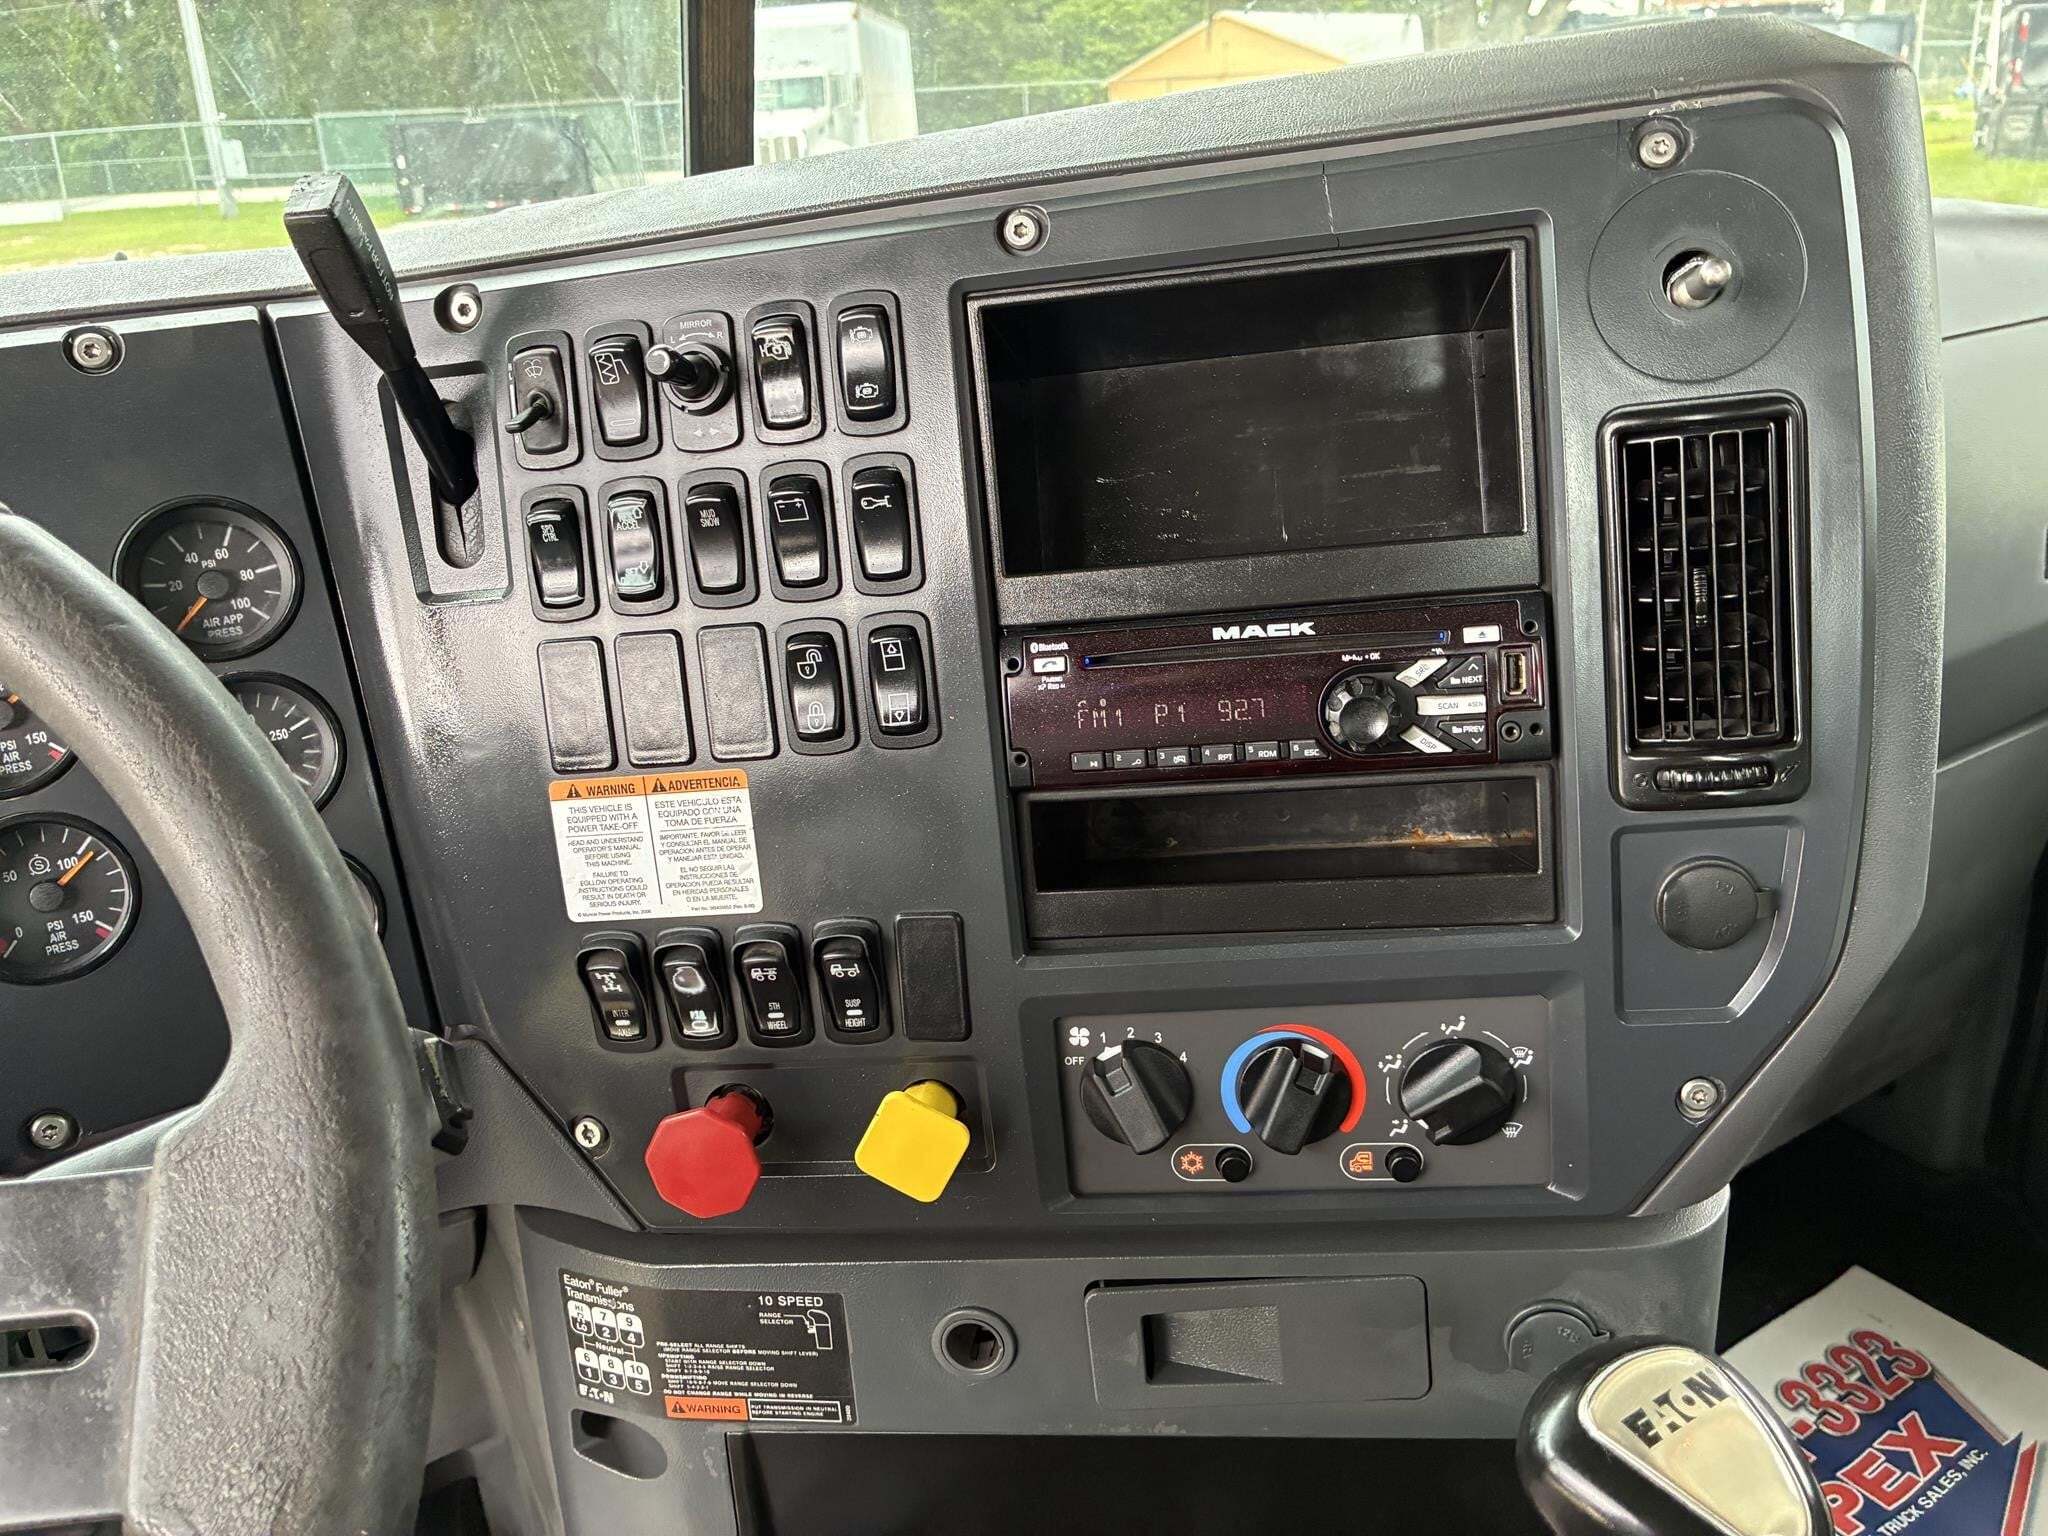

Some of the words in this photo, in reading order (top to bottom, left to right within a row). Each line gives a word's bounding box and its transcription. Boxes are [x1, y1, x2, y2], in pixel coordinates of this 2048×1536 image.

[680, 319, 712, 329] MIRROR
[670, 336, 676, 344] L
[716, 331, 723, 339] R
[700, 509, 716, 519] MUD
[616, 521, 641, 531] ACCEL
[700, 517, 720, 528] SNOW
[540, 524, 555, 535] SPD
[542, 533, 560, 543] CTRL
[184, 552, 199, 564] 40
[214, 548, 229, 560] 60
[201, 560, 217, 569] PSI
[240, 568, 255, 581] 80
[168, 580, 184, 592] 20
[231, 597, 251, 610] 100
[203, 616, 221, 628] AIR
[223, 613, 244, 626] APP
[207, 626, 244, 638] PRESS
[1212, 621, 1316, 640] MACK
[1038, 641, 1069, 652] Bluetooth
[1370, 652, 1381, 660] OK
[1461, 675, 1483, 684] NEXT
[1077, 708, 1122, 729] FM1
[1154, 702, 1186, 725] P1
[269, 727, 289, 742] 250
[1462, 725, 1485, 733] PREV
[25, 731, 47, 745] 150
[0, 740, 17, 752] PSI
[1420, 738, 1437, 751] DISP
[3, 751, 20, 763] AIR
[1159, 752, 1165, 760] 3
[1204, 748, 1210, 757] 4
[1218, 753, 1233, 761] RPT
[1248, 746, 1254, 754] 5
[1258, 750, 1277, 758] RDM
[1304, 748, 1320, 756] ESC
[0, 760, 32, 776] PRESS
[668, 776, 741, 791] ADVERTENCIA
[585, 783, 636, 797] WARNING
[568, 806, 587, 814] THIS
[589, 804, 622, 814] VEHICLE
[624, 803, 633, 811] IS
[655, 800, 676, 809] ESTE
[677, 798, 720, 808] VEHICULO
[721, 796, 742, 805] ESTA
[567, 815, 608, 824] EQUIPPED
[609, 813, 630, 822] WITH
[658, 808, 700, 819] EQUIPADO
[702, 806, 720, 816] CON
[568, 824, 598, 833] POWER
[600, 822, 639, 831] TAKE-OFF
[664, 819, 690, 828] TOMA
[692, 817, 704, 826] DE
[705, 815, 738, 825] FUERZA
[57, 856, 79, 871] 100
[2, 869, 18, 884] 50
[580, 879, 606, 887] FOLLOW
[608, 877, 644, 885] OPERATING
[582, 893, 606, 901] RESULT
[72, 910, 94, 925] 150
[47, 920, 65, 932] PSI
[15, 927, 23, 938] 0
[50, 931, 68, 943] AIR
[45, 940, 80, 956] PRESS
[768, 1002, 781, 1011] 5TH
[844, 998, 861, 1008] SUSP
[612, 1009, 630, 1018] INTER
[766, 1020, 789, 1030] WHEEL
[845, 1018, 866, 1027] HEIGHT
[1100, 1032, 1107, 1044] 1
[1126, 1026, 1135, 1040] 2
[1154, 1031, 1163, 1044] 3
[1064, 1056, 1085, 1067] OFF
[1179, 1051, 1187, 1063] 4
[564, 1286, 635, 1312] Transmissions
[758, 1295, 773, 1306] 10
[778, 1295, 824, 1307] SPEED
[600, 1311, 607, 1320] 7
[626, 1317, 633, 1327] 9
[601, 1327, 611, 1338] 2
[627, 1333, 636, 1343] 4
[595, 1341, 625, 1355] Neutral
[584, 1352, 591, 1362] 6
[608, 1359, 615, 1369] 8
[630, 1364, 644, 1375] 10
[586, 1367, 593, 1378] 1
[608, 1374, 618, 1385] 3
[634, 1380, 644, 1391] 5
[686, 1403, 741, 1415] WARNING
[1621, 1368, 1730, 1449] EATON
[1820, 1410, 1967, 1536] PEX
[1877, 1505, 1925, 1536] TRUCK
[1918, 1467, 1969, 1508] SALES,
[1959, 1449, 1990, 1471] INC.
